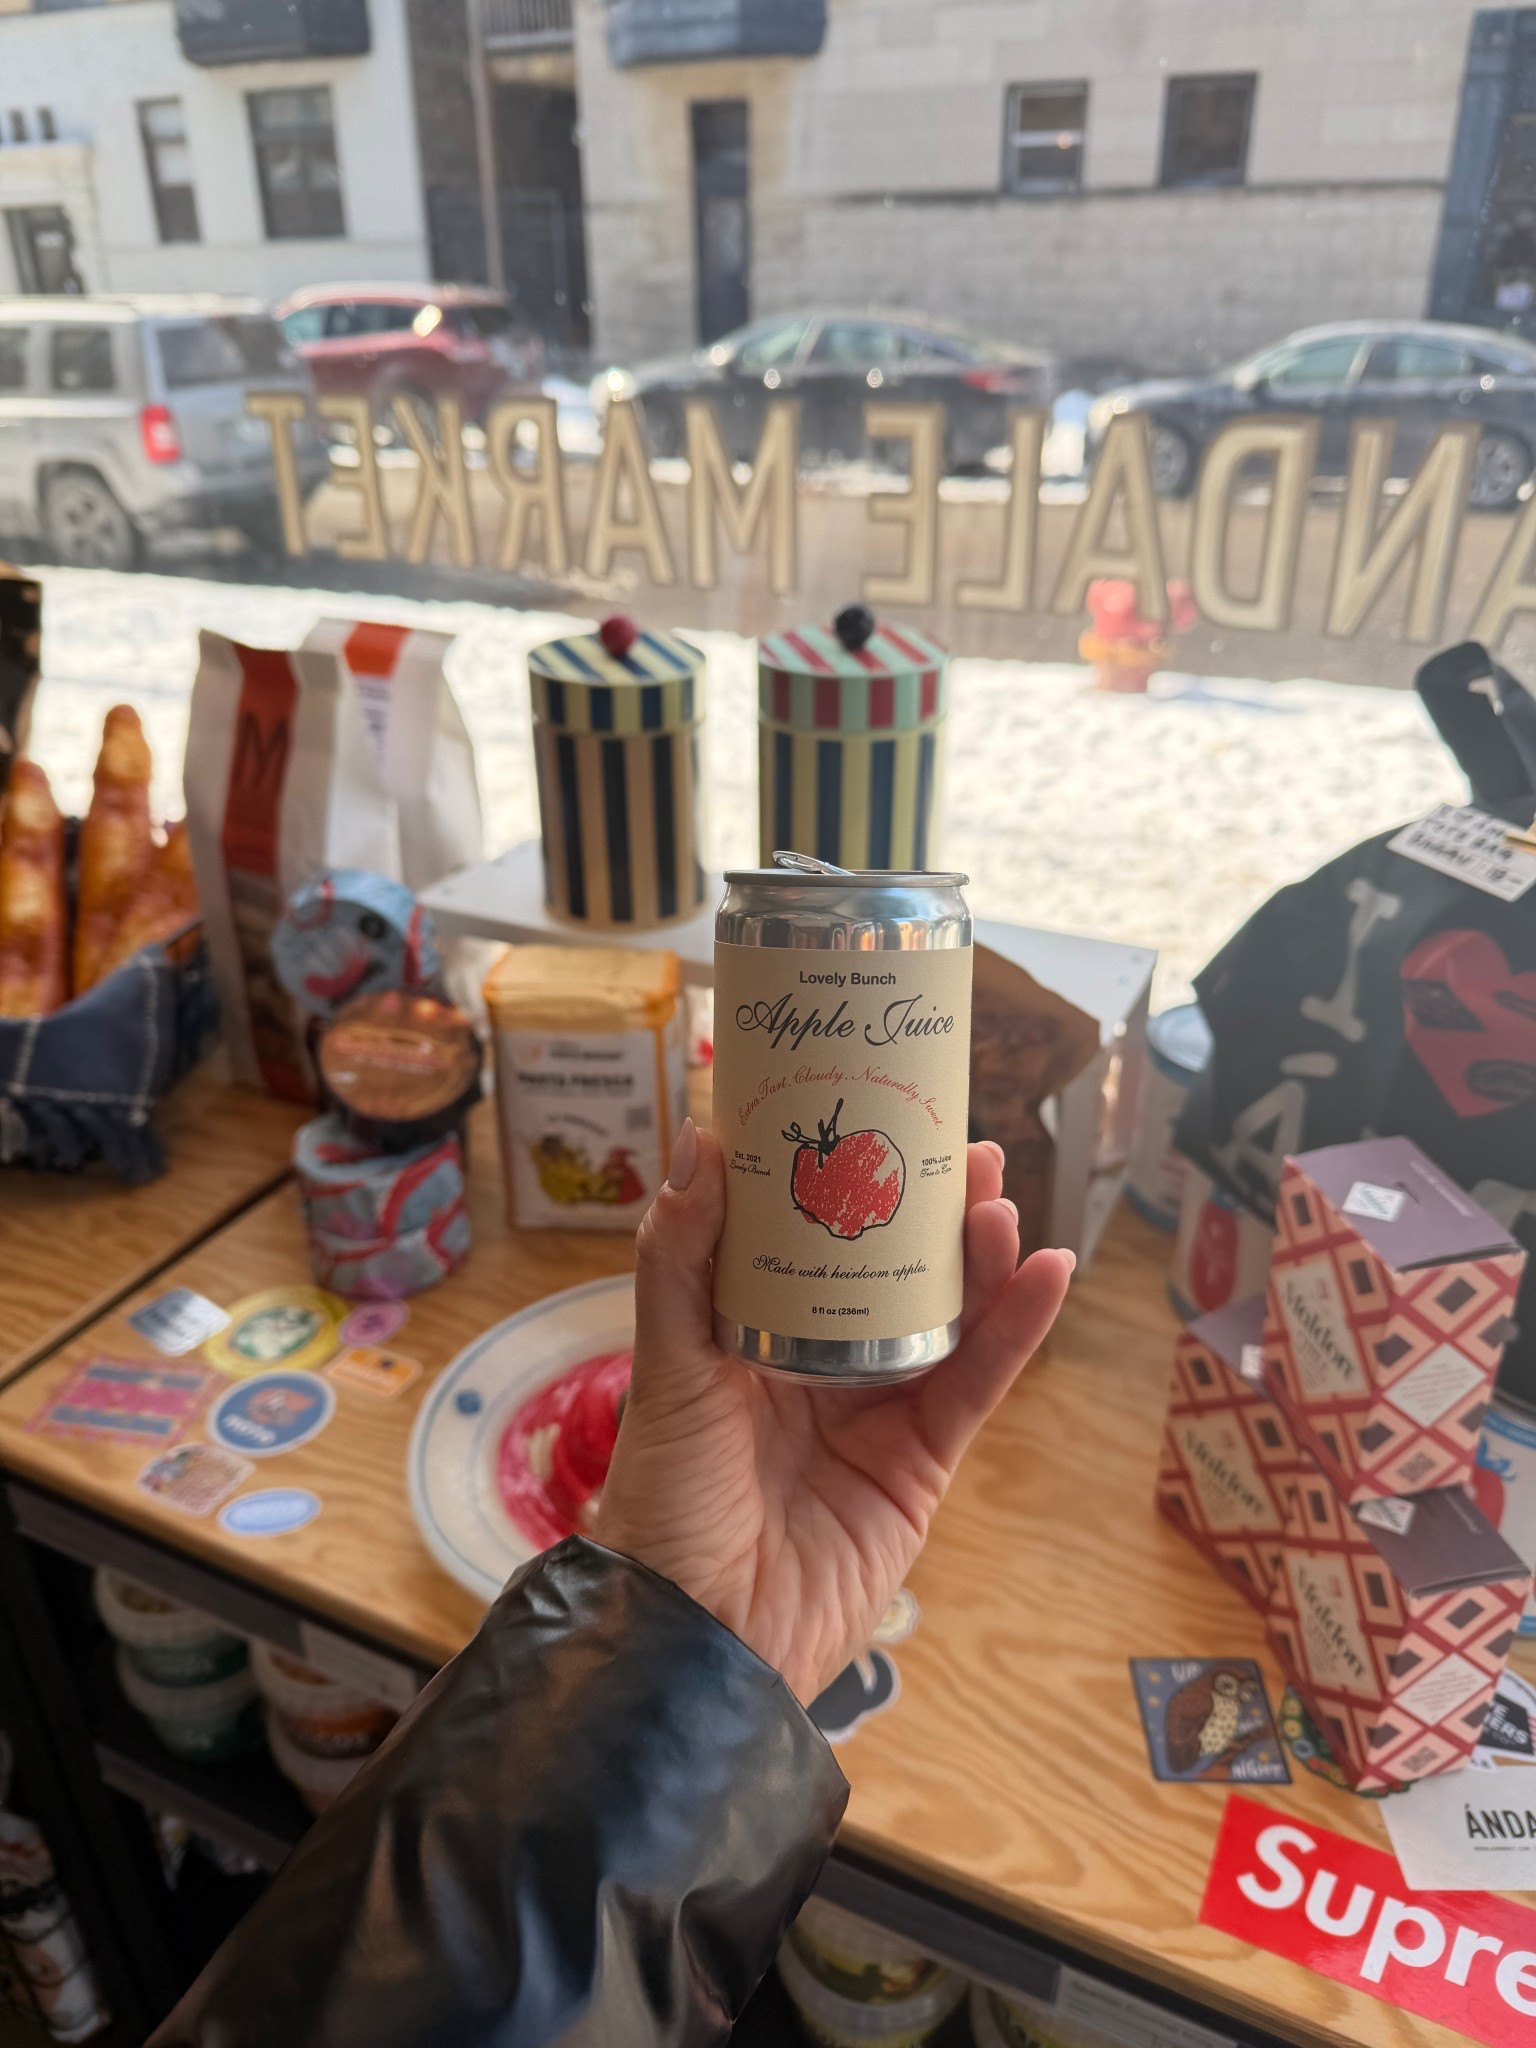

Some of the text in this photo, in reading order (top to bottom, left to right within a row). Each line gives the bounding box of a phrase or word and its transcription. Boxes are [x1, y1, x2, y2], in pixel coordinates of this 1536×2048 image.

[800, 971, 896, 987] Lovely Bunch
[736, 993, 954, 1050] Apple Juice
[739, 1098, 760, 1126] Extra
[793, 1065, 847, 1086] Cloudy.
[852, 1065, 919, 1102] Naturally
[746, 1153, 761, 1163] 2021
[922, 1155, 951, 1166] 100% Juice
[748, 1164, 771, 1177] Bunch
[752, 1254, 930, 1281] Made with heirloom apples.
[812, 1306, 817, 1314] 8
[838, 1307, 870, 1316] (236ml)
[1236, 1824, 1536, 2018] Supre
